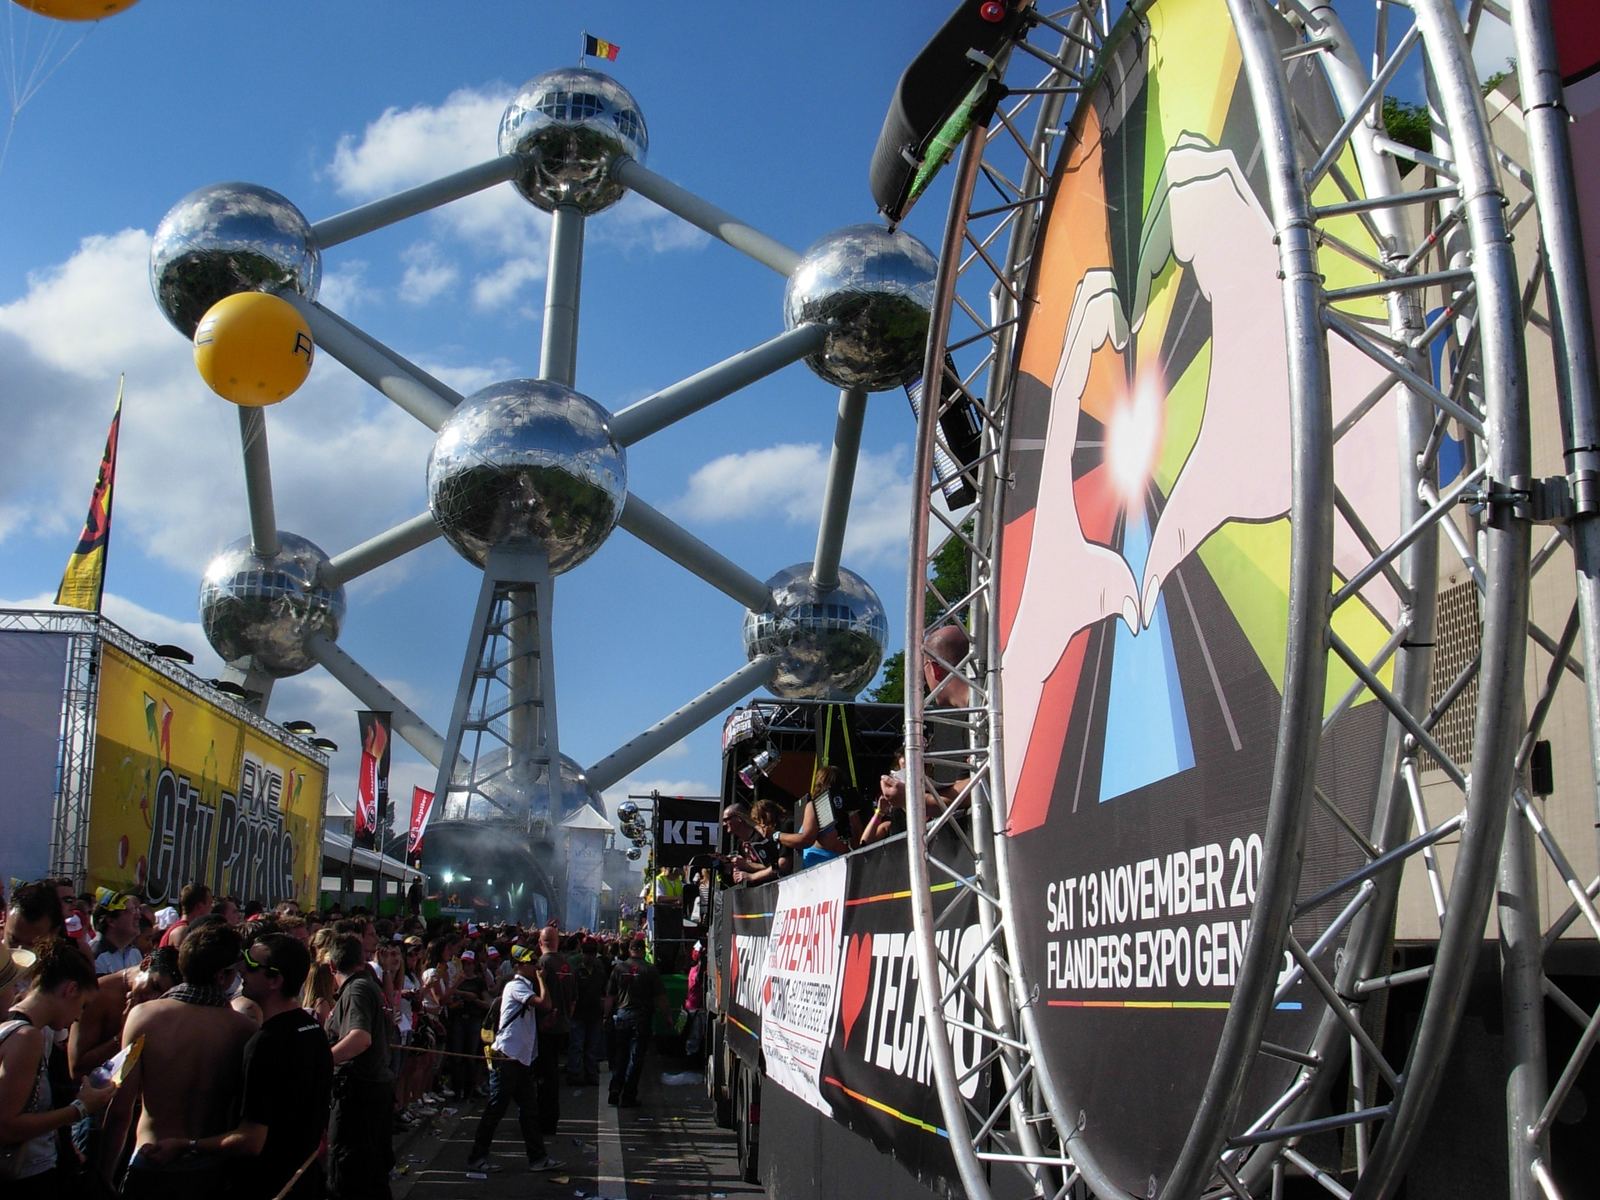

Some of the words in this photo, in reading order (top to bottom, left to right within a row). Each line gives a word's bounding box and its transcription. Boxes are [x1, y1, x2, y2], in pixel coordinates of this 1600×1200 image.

[146, 768, 216, 904] City
[212, 790, 295, 906] Parade
[1047, 877, 1076, 933] SAT
[1079, 873, 1099, 928] 13
[1101, 843, 1225, 926] NOVEMBER
[1229, 833, 1263, 908] 20
[1047, 933, 1132, 989] FLANDERS
[1135, 928, 1191, 988] EXPO
[1195, 919, 1251, 987] GEN
